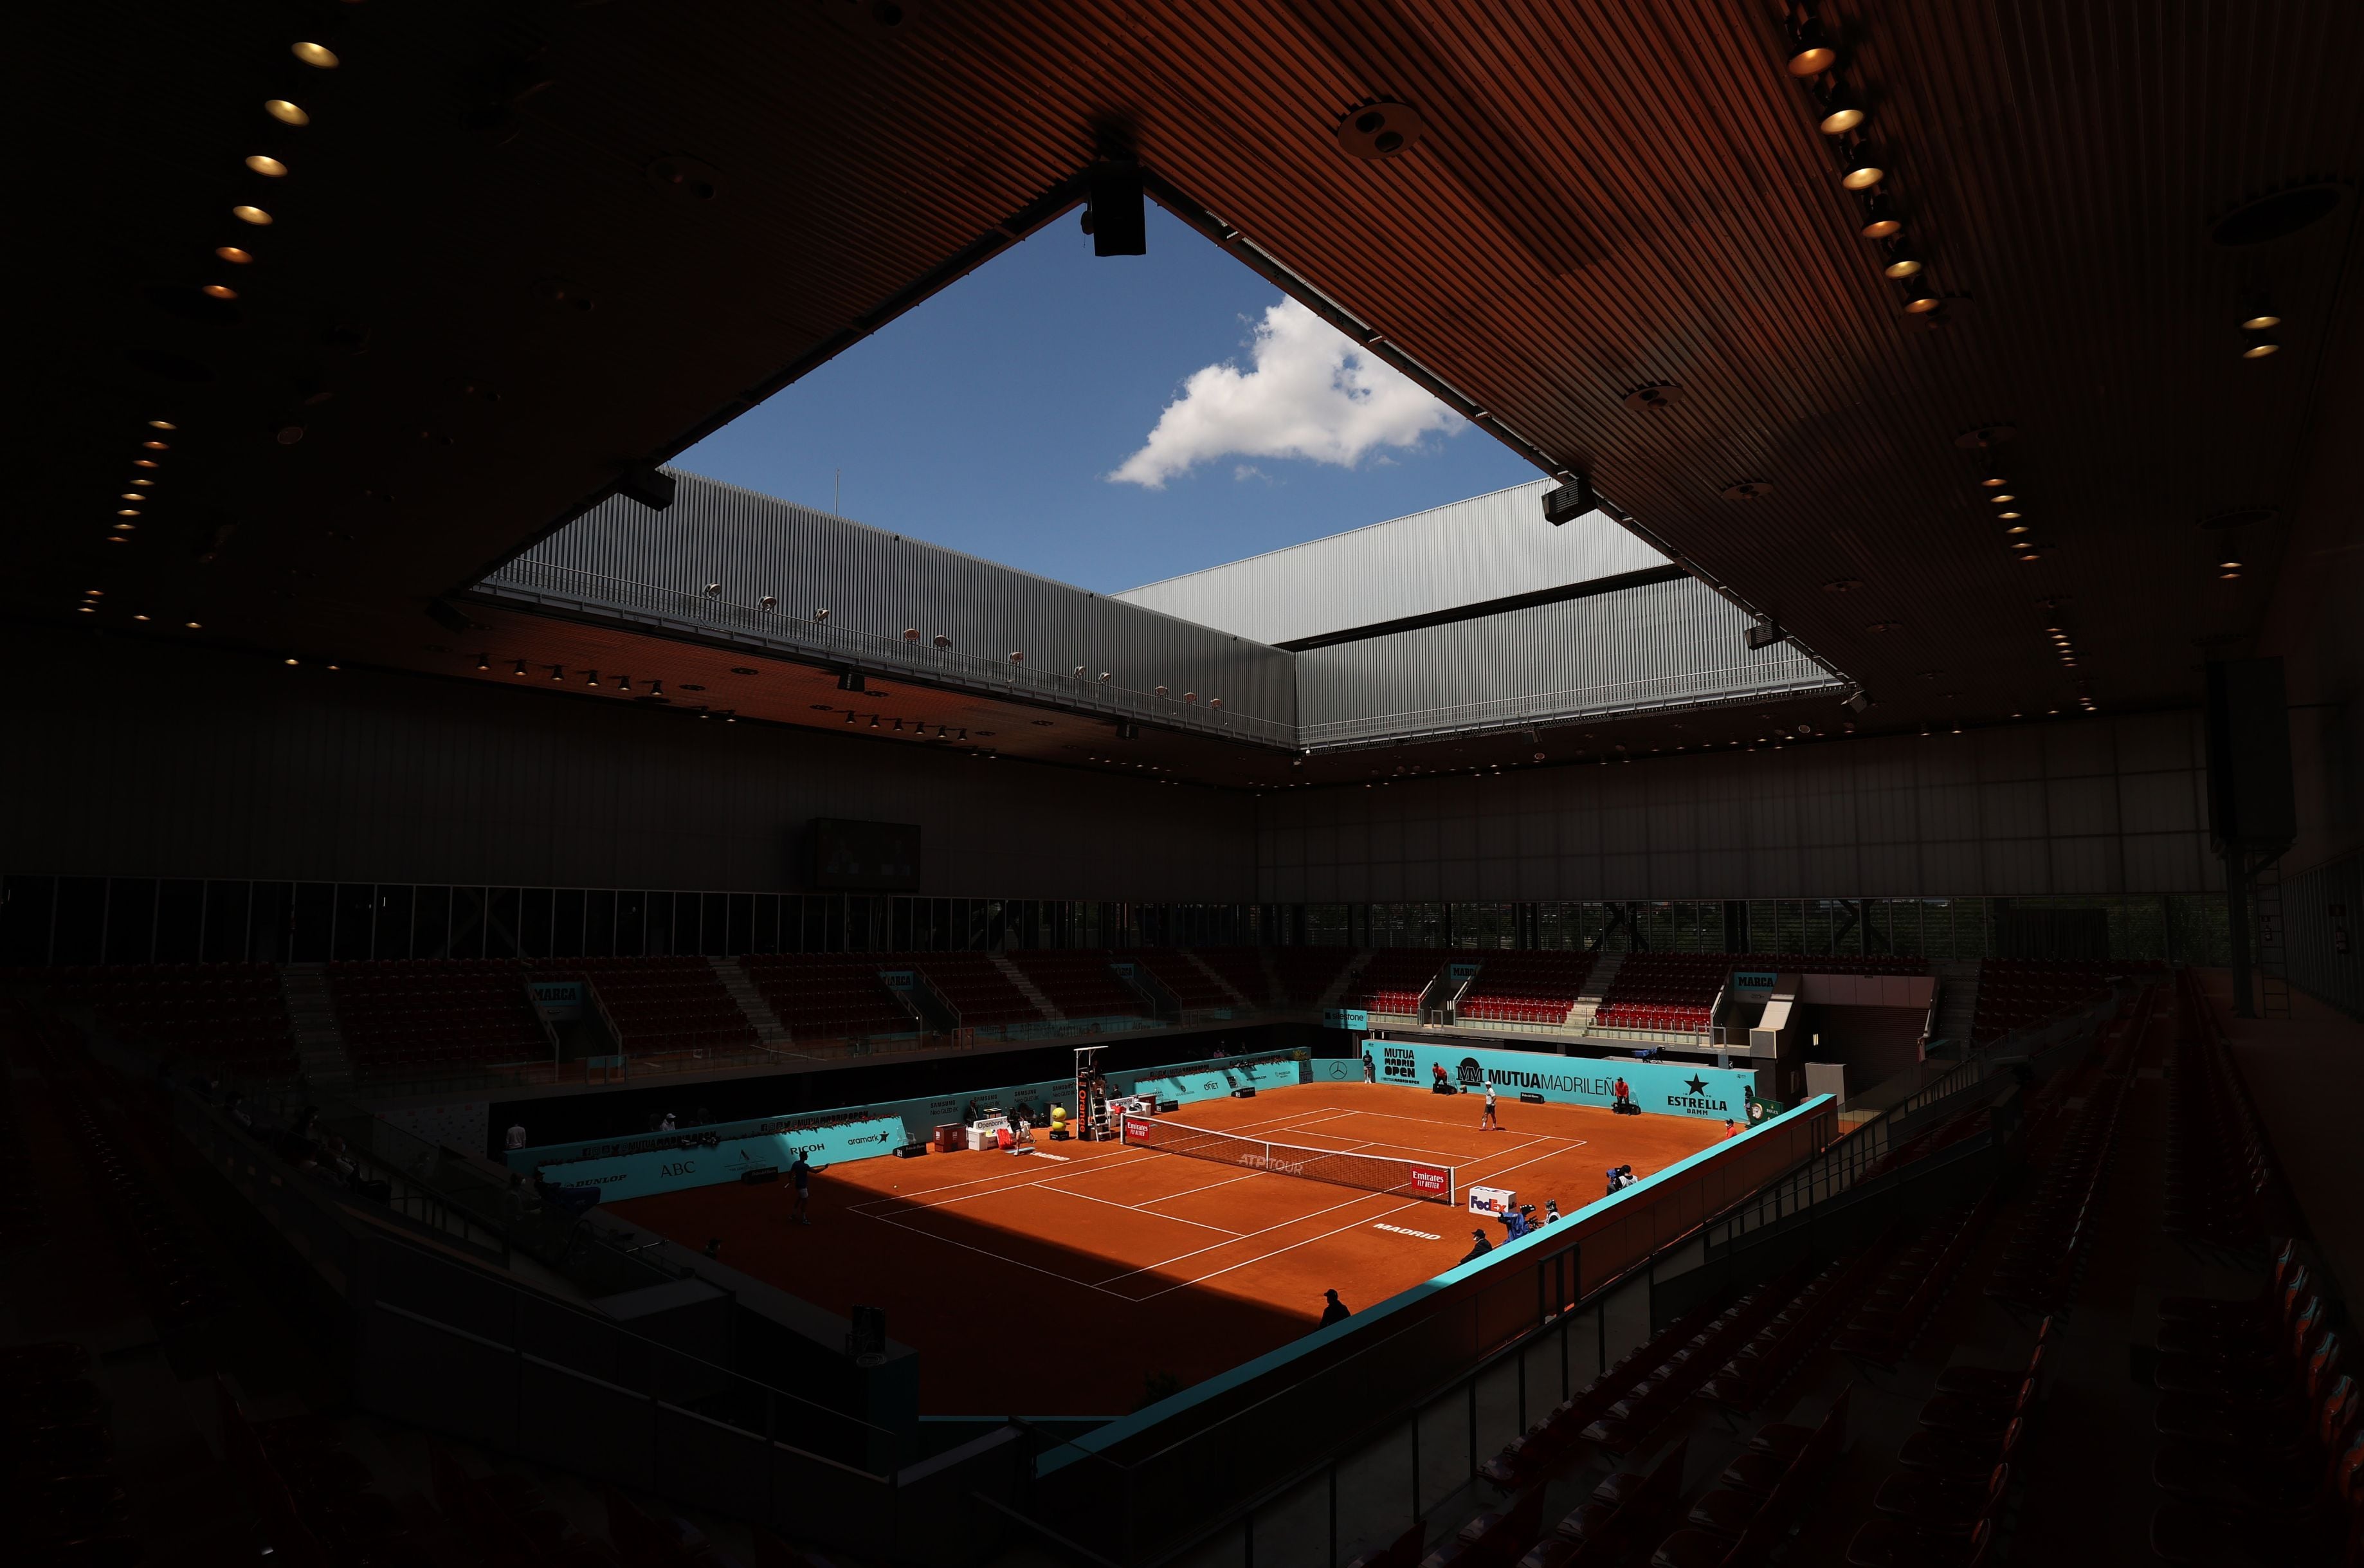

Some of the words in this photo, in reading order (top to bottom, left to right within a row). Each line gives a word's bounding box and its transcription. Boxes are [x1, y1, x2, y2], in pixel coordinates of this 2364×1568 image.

[1453, 967, 1476, 976] MARC
[1738, 977, 1774, 987] MARCA
[1384, 1048, 1415, 1059] MUTUA
[1385, 1058, 1415, 1067] MADRID
[1385, 1066, 1415, 1078] OPEN
[1488, 1069, 1615, 1097] MUTUAMADRILEÑ
[931, 1100, 956, 1108] SAMSUNG
[1668, 1095, 1727, 1111] ESTRELLA
[1078, 1089, 1087, 1133] Orange
[977, 1119, 1004, 1129] Openbank
[1127, 1122, 1149, 1132] Emirates
[848, 1134, 879, 1145] aramark
[790, 1144, 825, 1155] RICOH
[660, 1161, 696, 1178] ABC
[1237, 1153, 1266, 1167] ATP
[1268, 1158, 1303, 1175] TOUR
[576, 1174, 627, 1187] DUNLOP
[1412, 1171, 1444, 1183] Emirates
[1424, 1181, 1439, 1189] BETTER
[1471, 1196, 1506, 1212] FedEx
[1372, 1223, 1441, 1240] MADRID
